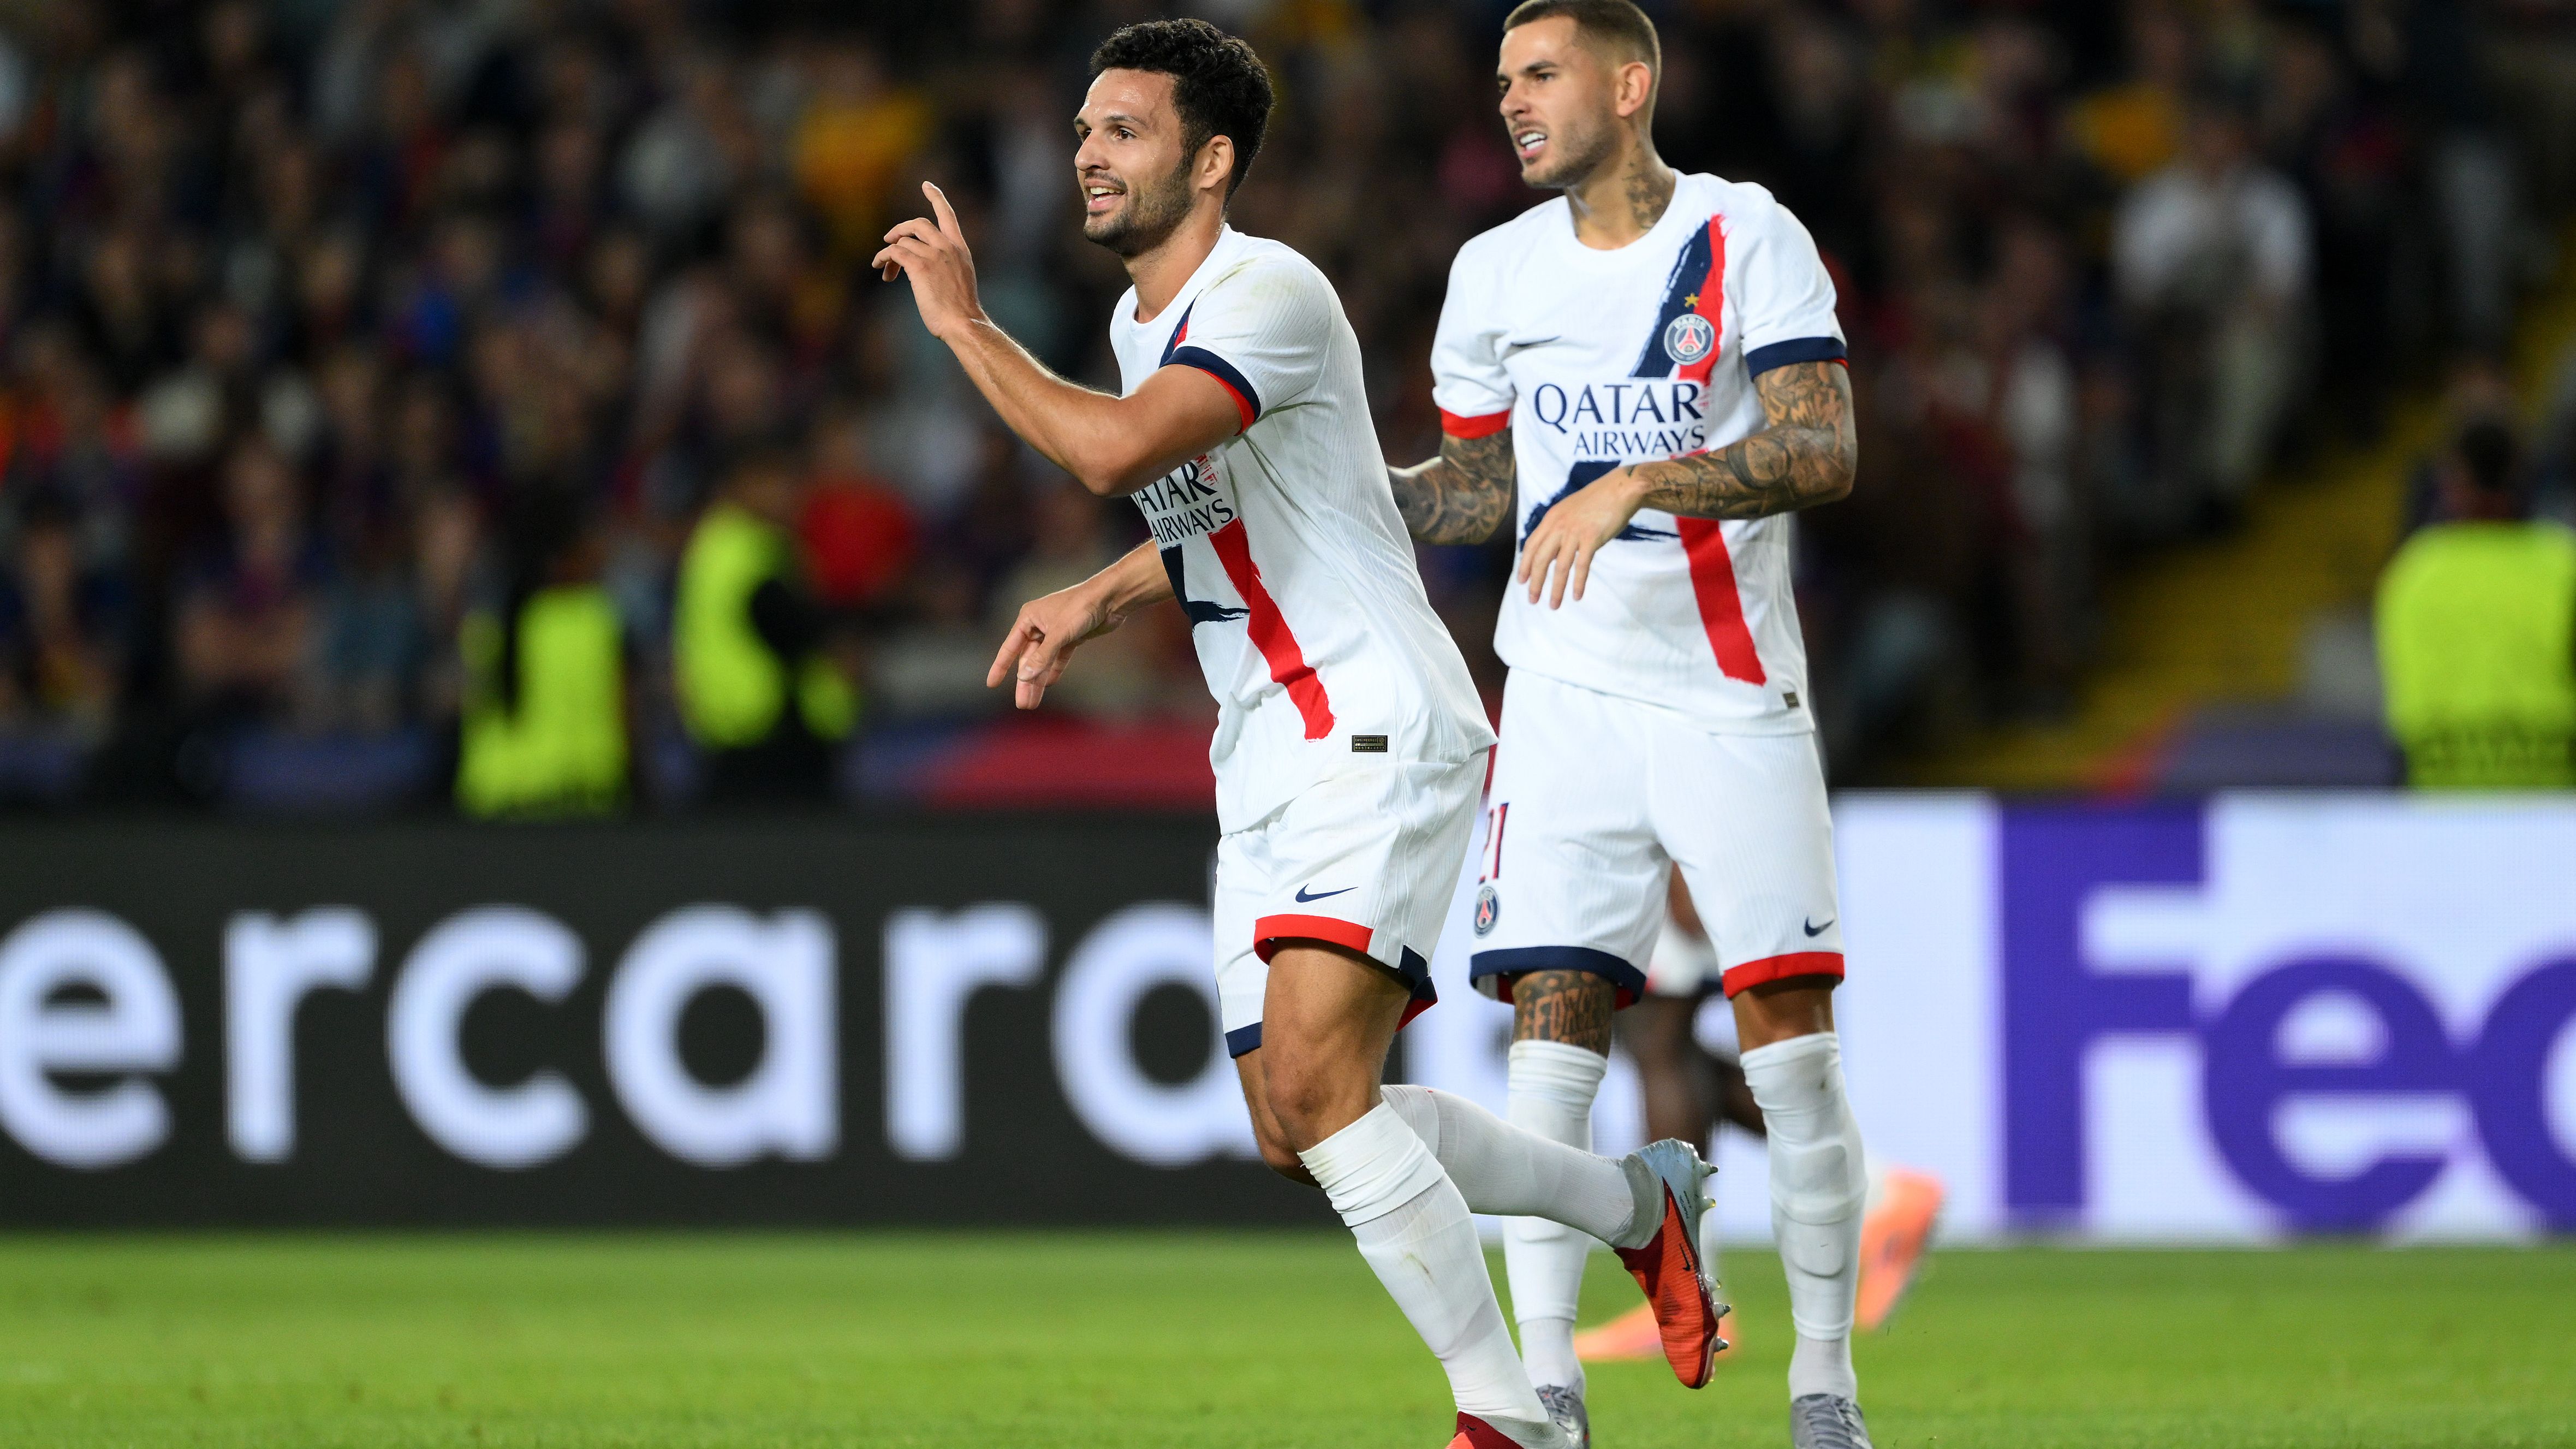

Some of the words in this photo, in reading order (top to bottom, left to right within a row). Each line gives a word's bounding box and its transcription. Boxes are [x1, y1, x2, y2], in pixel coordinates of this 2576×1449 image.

[1533, 383, 1703, 434] QATAR
[1573, 425, 1705, 456] AIRWAYS
[1132, 460, 1218, 514] AAR
[1151, 498, 1234, 545] AIRWAYS
